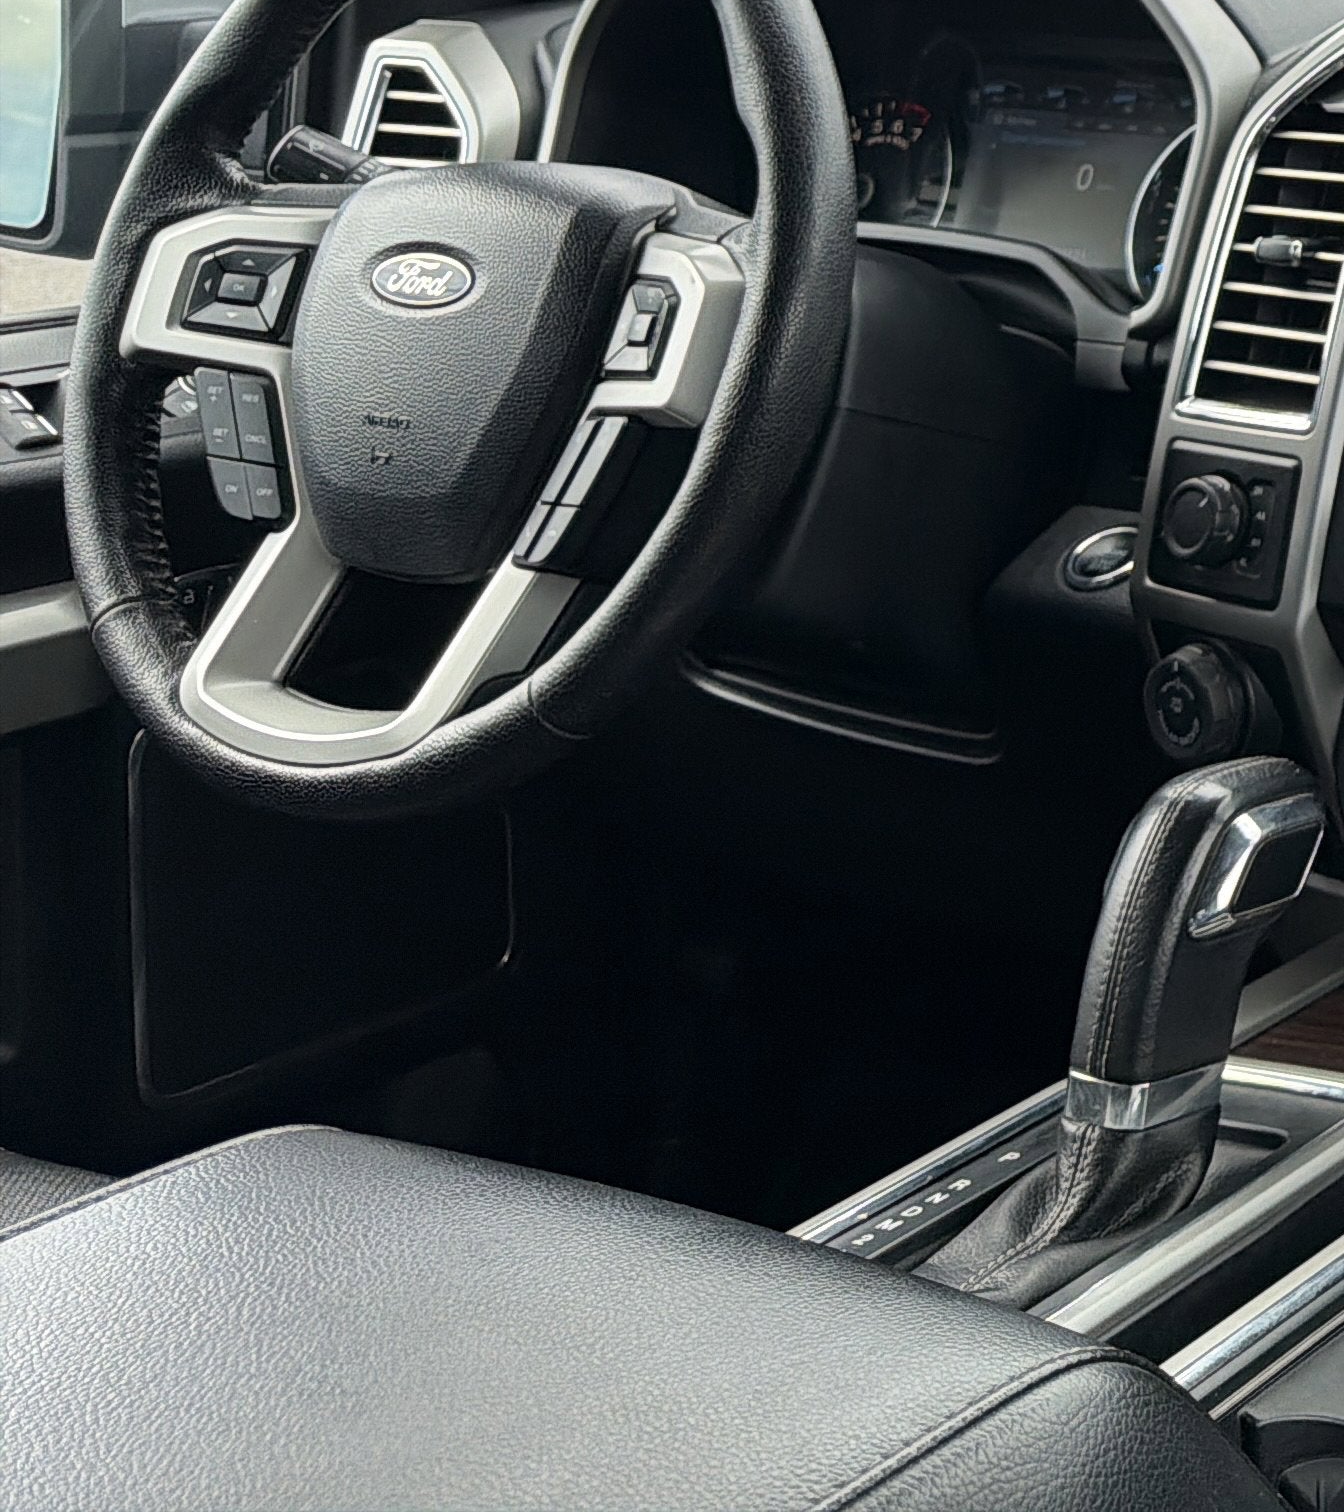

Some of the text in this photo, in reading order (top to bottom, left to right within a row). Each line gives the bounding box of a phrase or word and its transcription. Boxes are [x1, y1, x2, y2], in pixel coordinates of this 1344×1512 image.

[1076, 163, 1094, 191] 0
[997, 1151, 1022, 1164] P
[947, 1178, 972, 1191] R
[925, 1191, 950, 1206] N
[900, 1205, 923, 1218] D
[874, 1217, 905, 1232] M
